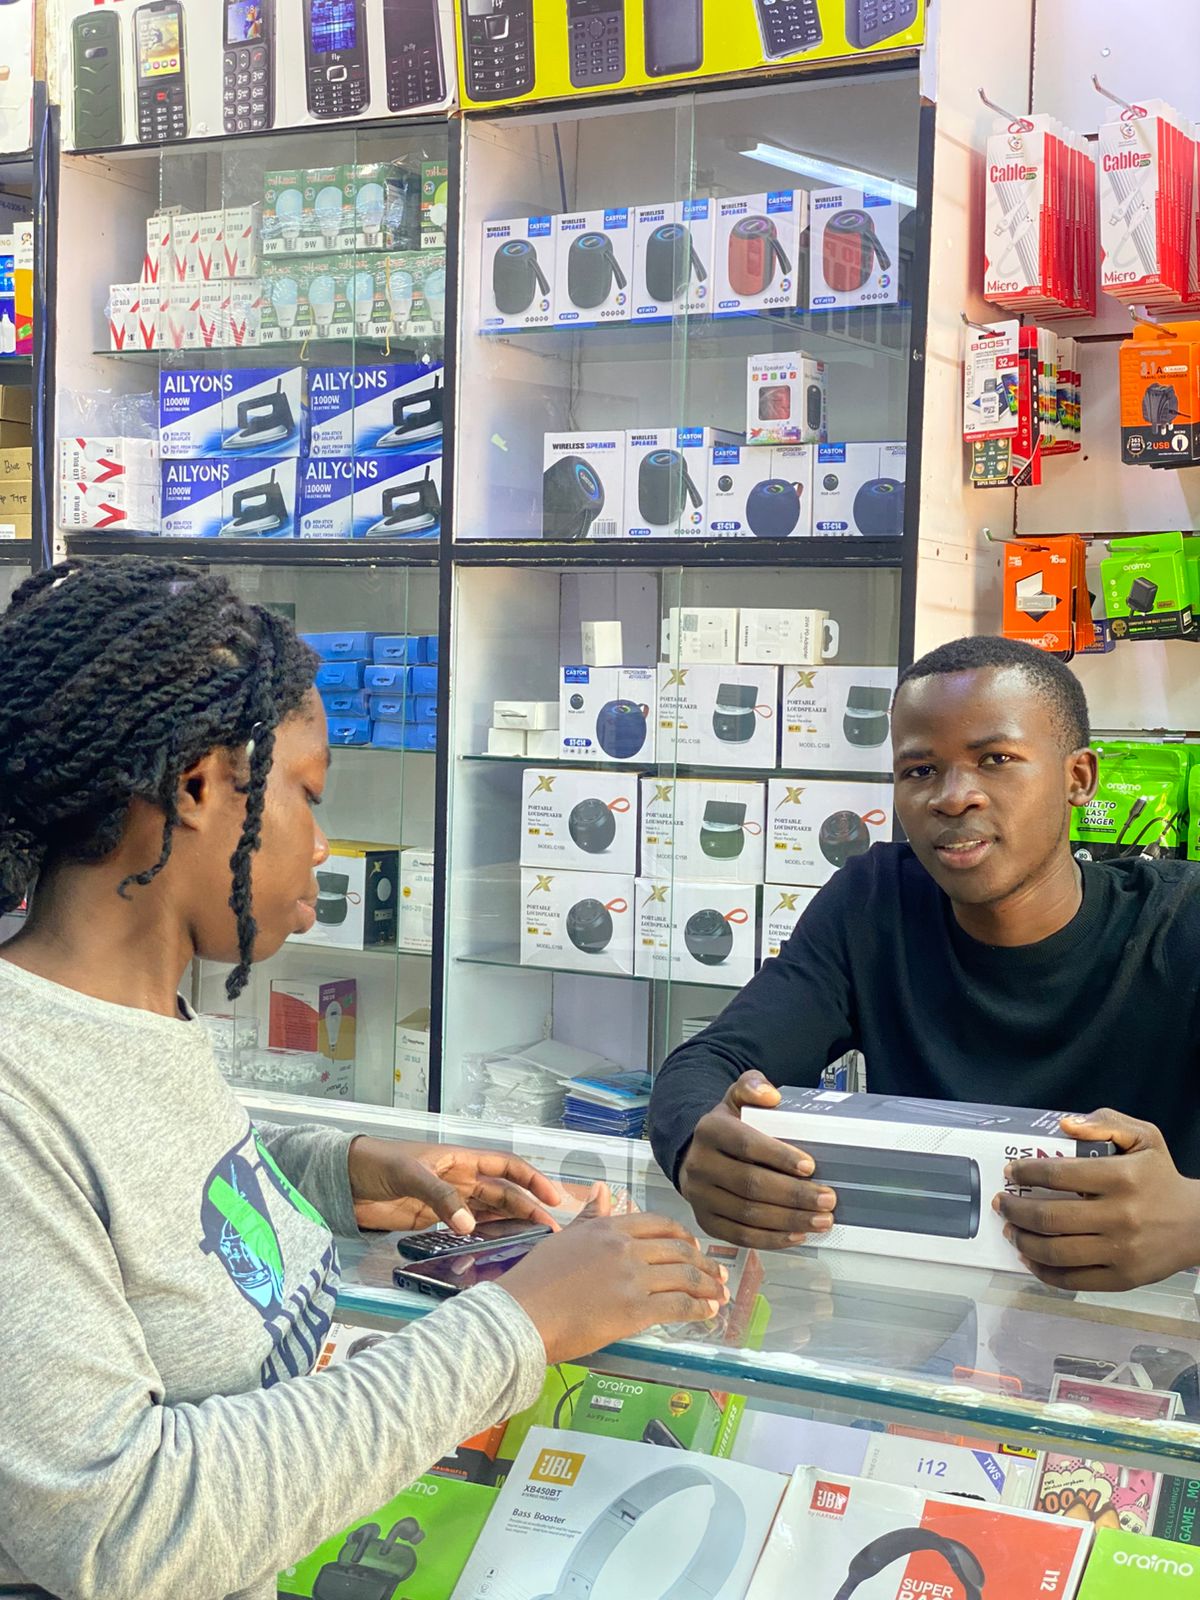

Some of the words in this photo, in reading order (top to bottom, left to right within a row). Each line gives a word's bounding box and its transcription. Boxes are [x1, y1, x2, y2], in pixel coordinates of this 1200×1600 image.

[1103, 151, 1140, 172] Cable
[990, 163, 1026, 183] Cable
[768, 196, 792, 204] CASTON
[721, 202, 747, 210] WIRELESS
[815, 202, 842, 210] SPEAKER
[721, 208, 747, 216] SPEAKER
[605, 214, 627, 222] CASTON
[639, 215, 664, 223] SPEAKER
[424, 236, 437, 244] 9W
[1104, 271, 1136, 284] Micro
[987, 279, 1018, 292] Micro
[299, 329, 310, 337] 9W
[375, 326, 387, 334] 9W
[263, 331, 273, 339] 9W
[970, 338, 1012, 351] BOOST
[164, 374, 233, 393] AILYONS
[311, 370, 387, 391] AILYONS
[166, 398, 190, 406] 1000W
[314, 396, 340, 405] 1000W
[1153, 441, 1170, 449] USB
[167, 464, 229, 482] AILYONS
[306, 461, 378, 480] AILYONS
[168, 487, 192, 495] 1000W
[307, 484, 332, 493] 1000W
[1123, 563, 1151, 571] oraimo
[1082, 801, 1104, 809] UILT
[1086, 809, 1107, 817] LAST
[1080, 817, 1114, 826] LONGER
[597, 1380, 643, 1394] oraimo
[917, 1458, 947, 1477] i12
[983, 1457, 1001, 1481] TWS
[524, 1484, 562, 1497] XB450BT
[1037, 1488, 1102, 1514] OOM
[512, 1508, 531, 1518] Bass
[533, 1511, 566, 1524] Booster
[1179, 1506, 1196, 1542] GAME
[1113, 1551, 1193, 1577] oraimo
[902, 1578, 954, 1599] SUPER
